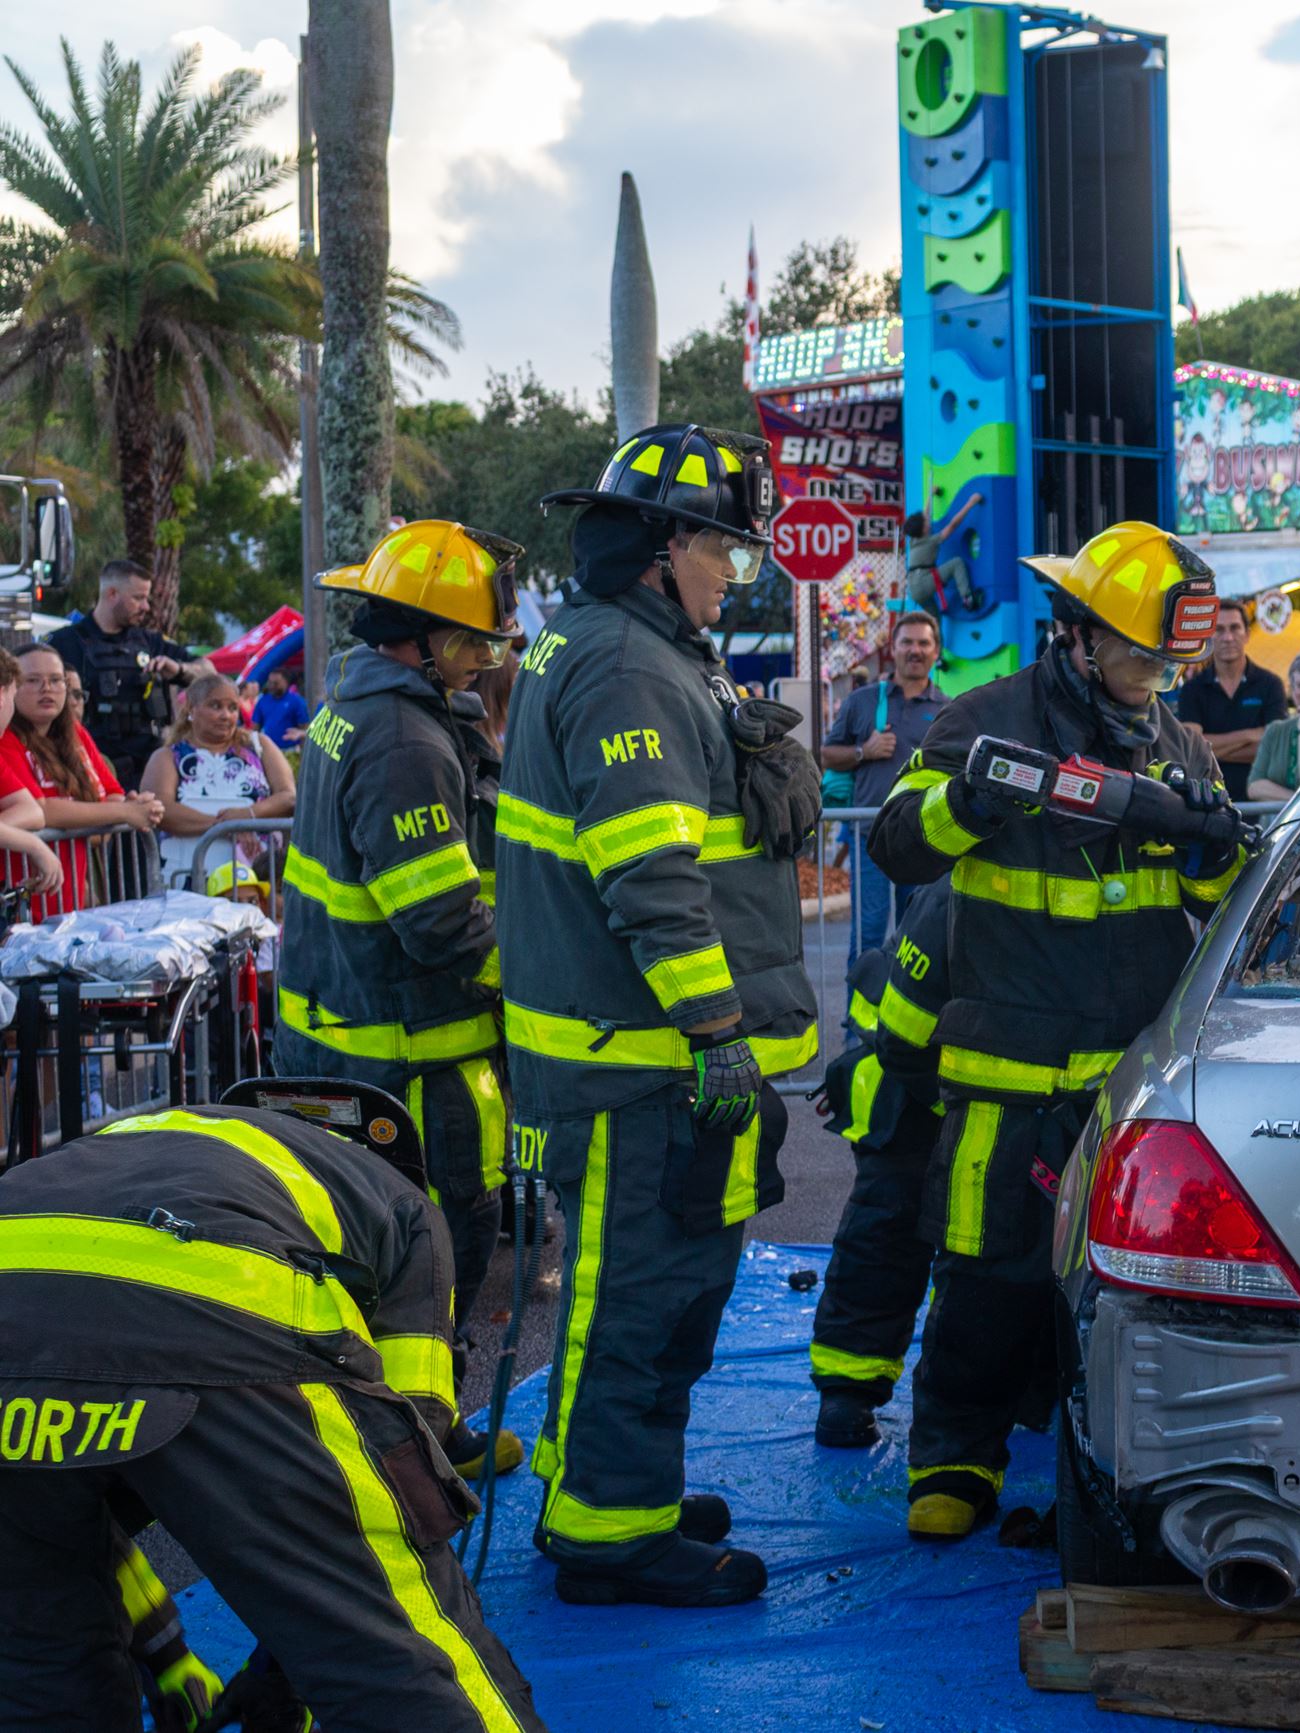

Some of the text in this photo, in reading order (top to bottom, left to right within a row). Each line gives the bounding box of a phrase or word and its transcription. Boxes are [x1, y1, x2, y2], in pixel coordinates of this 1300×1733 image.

[758, 329, 836, 384] HOOP
[804, 404, 898, 431] HOOP
[780, 436, 899, 468] SHOTS
[807, 478, 903, 504] ONE IN
[775, 523, 851, 557] STOP
[600, 728, 664, 767] MFR
[392, 803, 451, 842] MFD
[896, 935, 931, 981] MFD
[0, 1397, 146, 1462] ORTH
